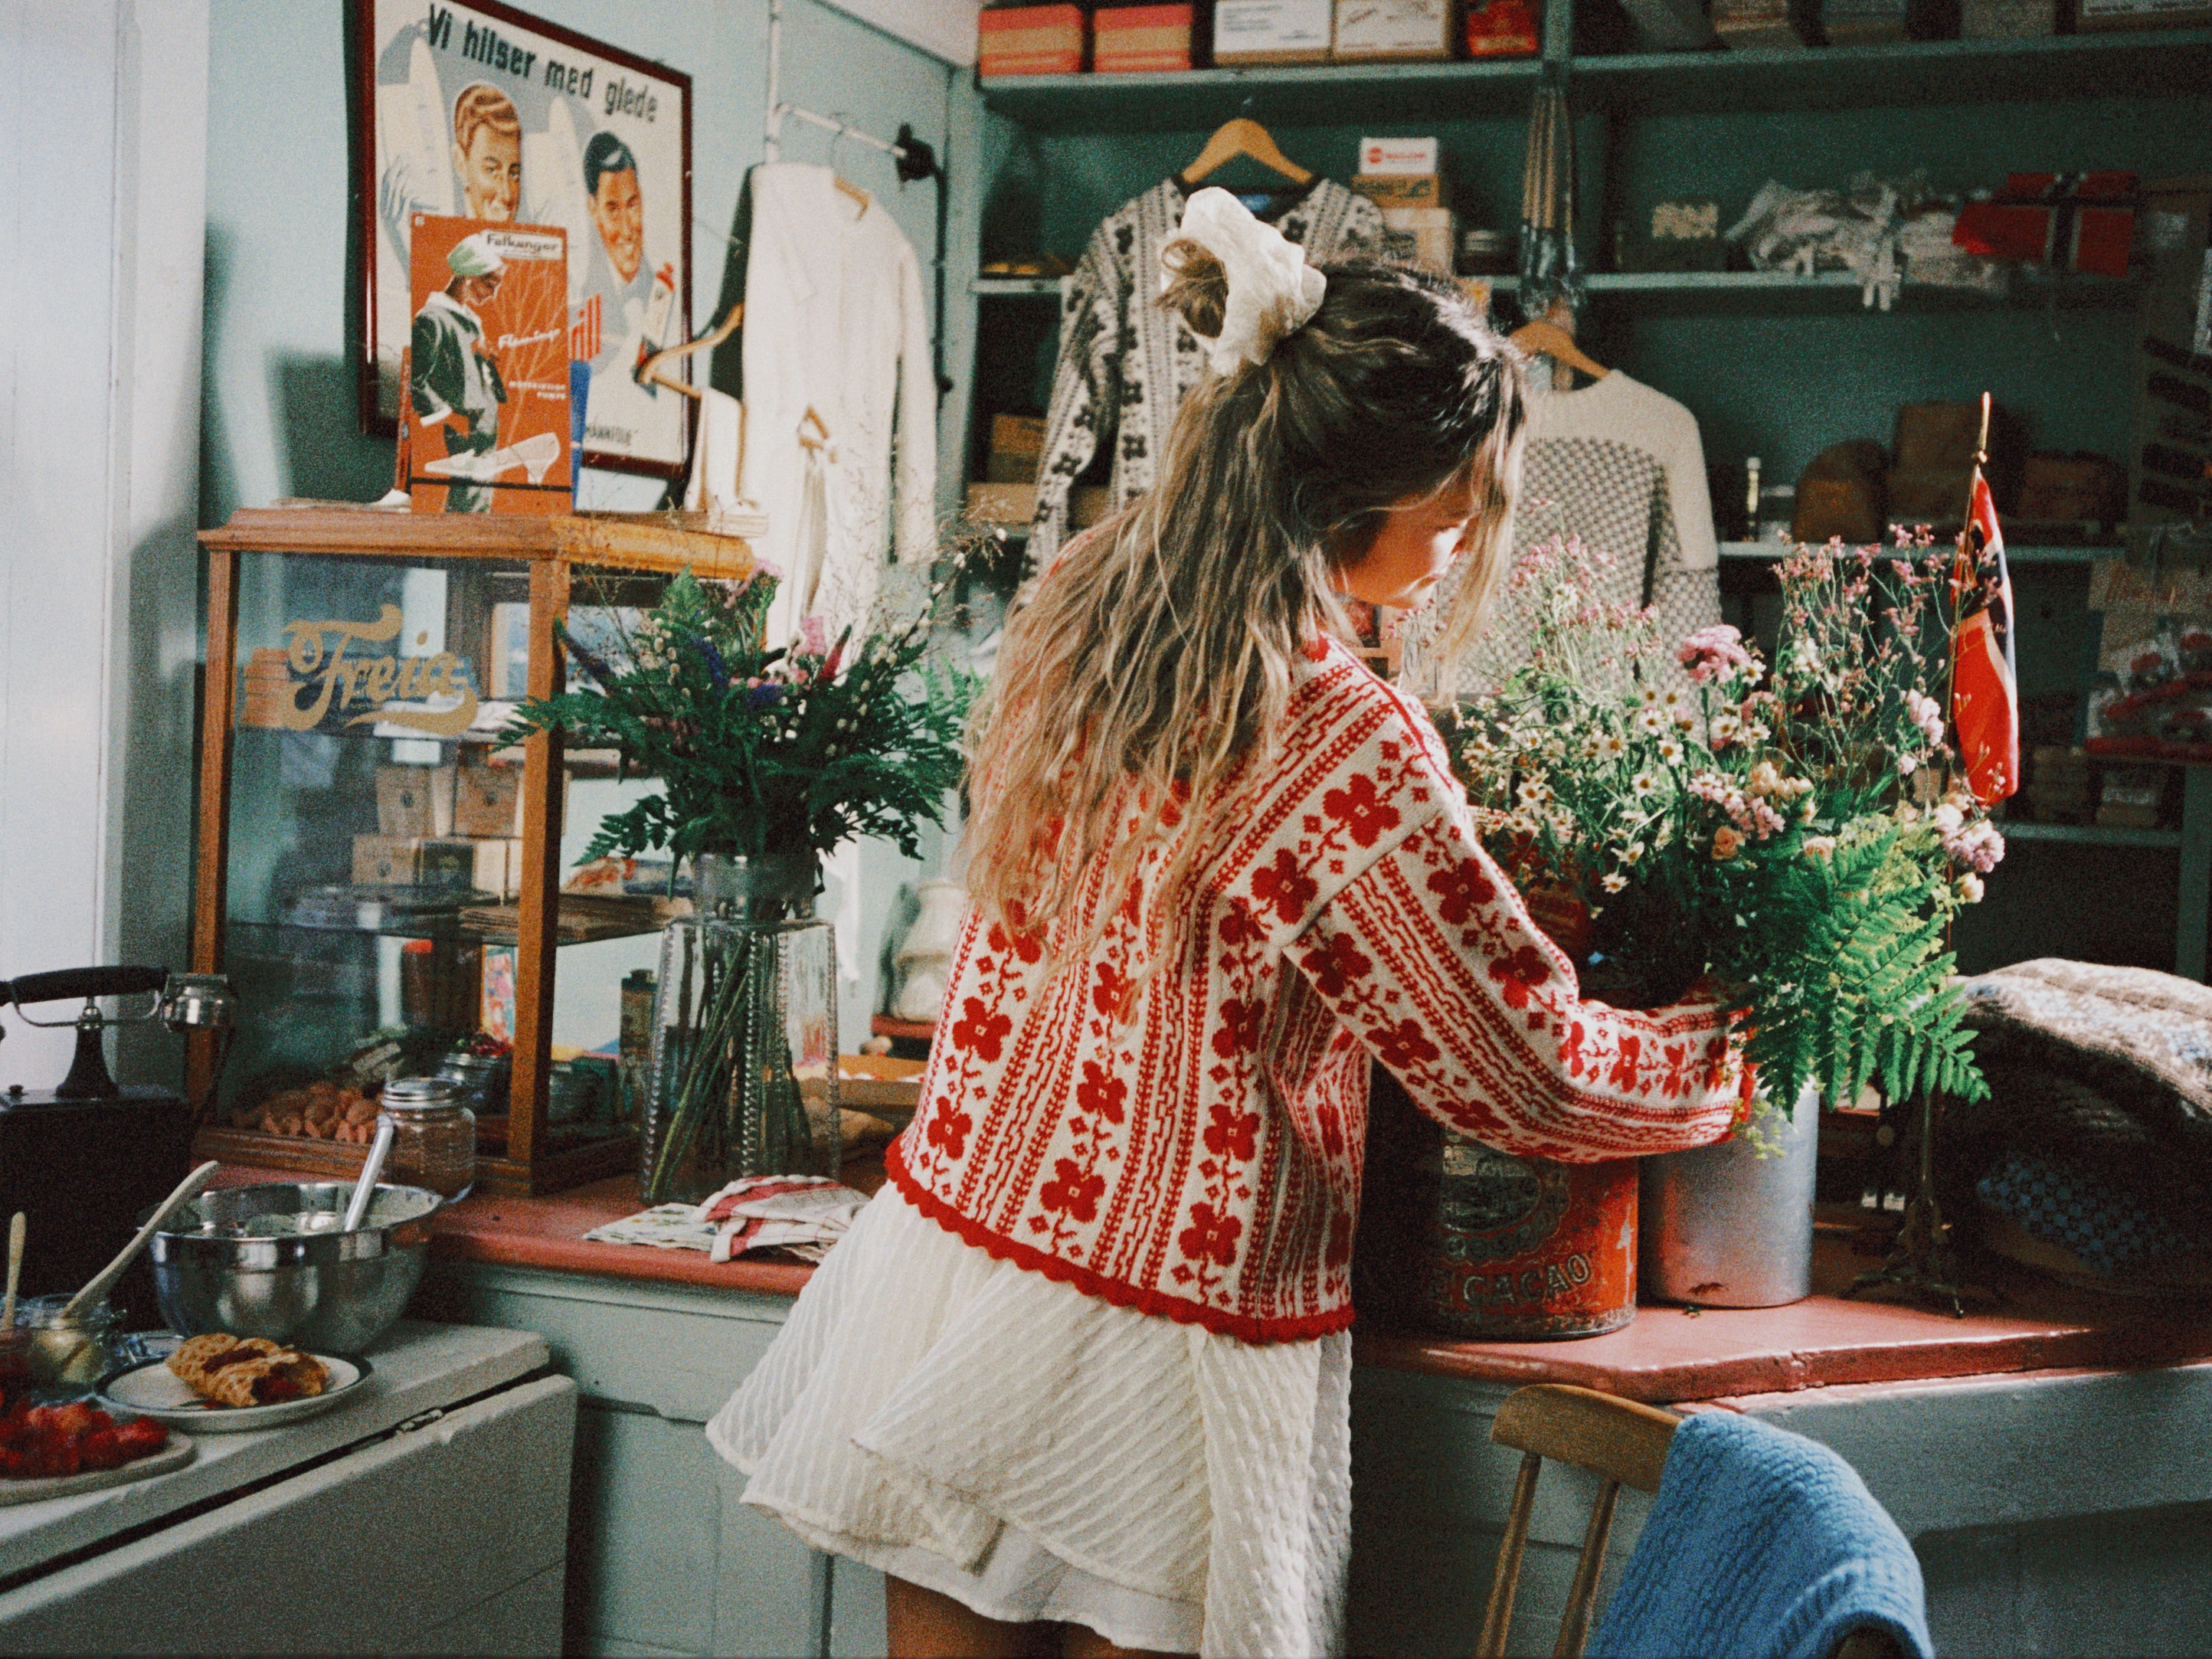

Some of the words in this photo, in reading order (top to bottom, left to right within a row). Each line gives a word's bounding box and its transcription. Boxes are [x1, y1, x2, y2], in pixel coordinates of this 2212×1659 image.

[428, 2, 453, 50] Vi
[462, 21, 536, 78] hilser
[544, 59, 594, 99] med
[604, 78, 659, 124] glede
[280, 604, 479, 736] Freia
[1463, 1254, 1590, 1304] CACAO
